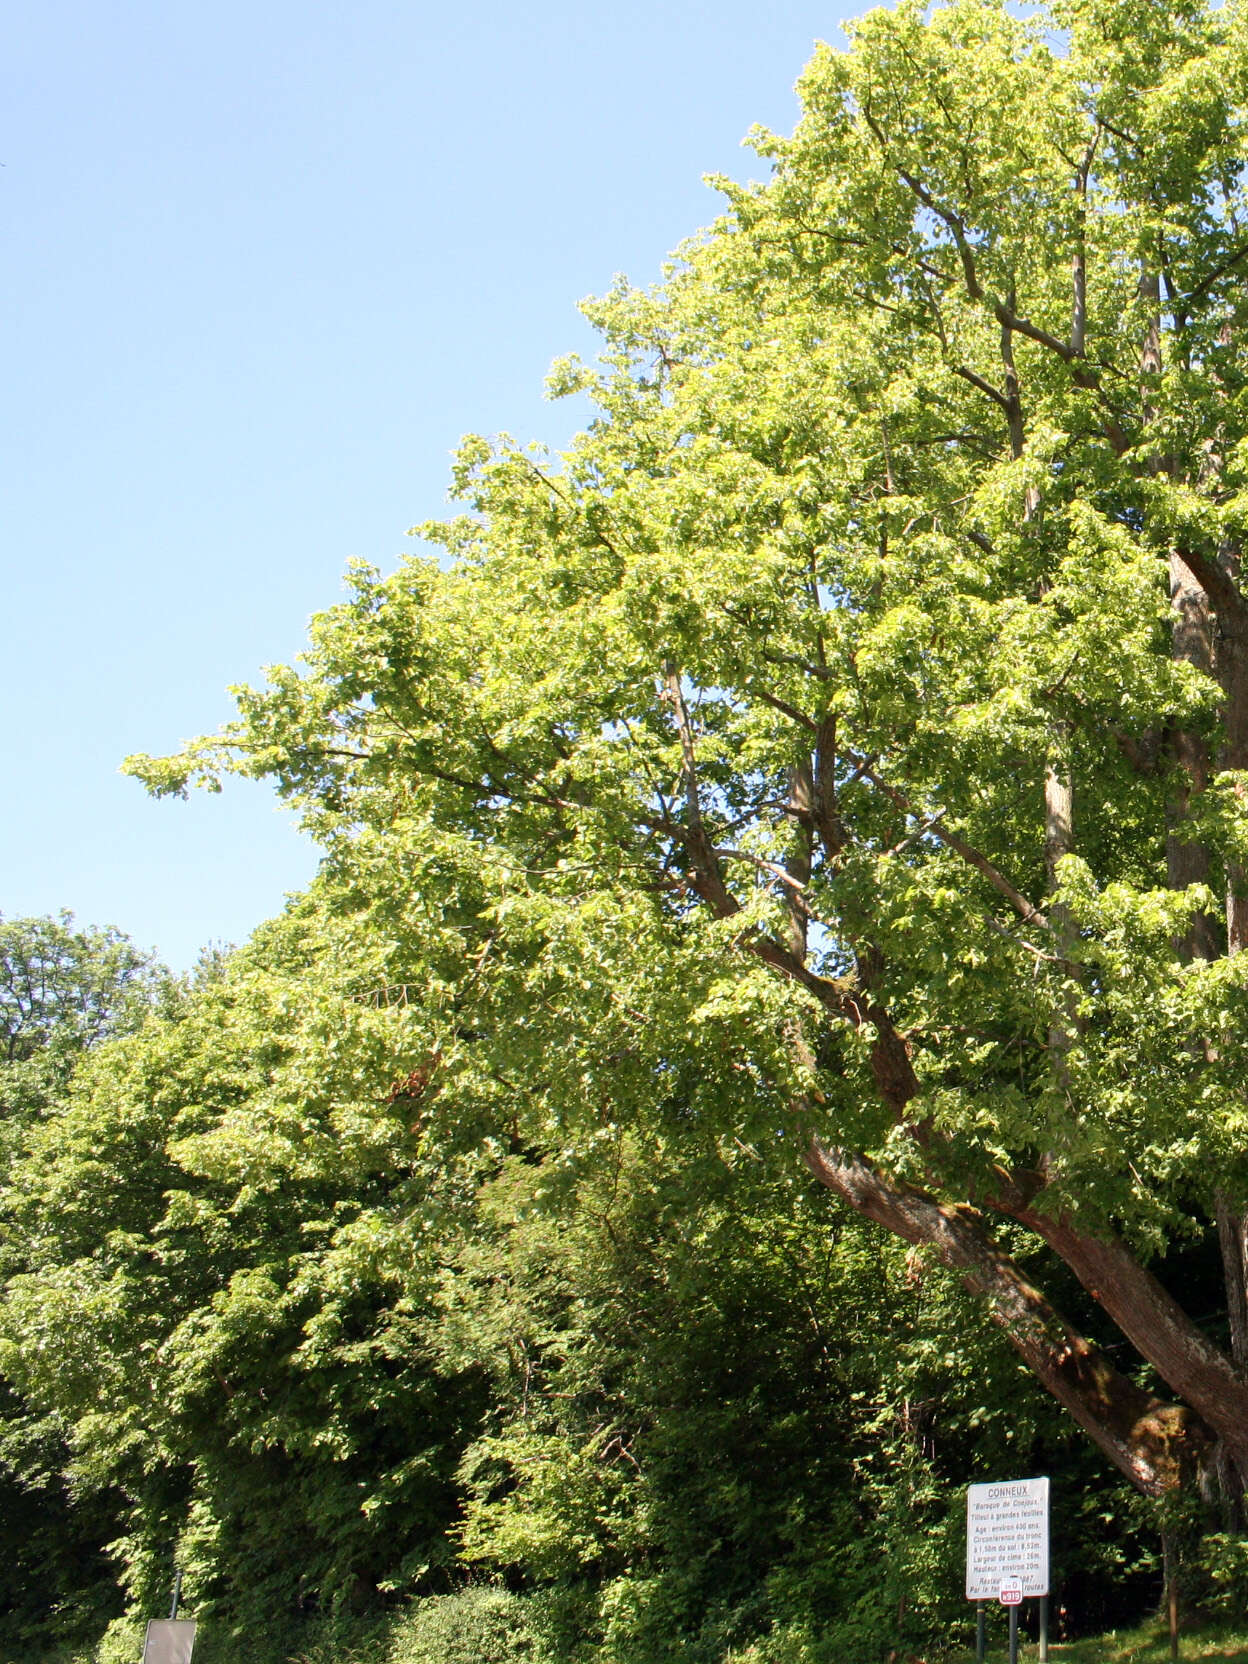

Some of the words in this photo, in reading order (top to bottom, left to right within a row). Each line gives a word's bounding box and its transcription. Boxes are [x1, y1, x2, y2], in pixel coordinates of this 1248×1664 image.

[988, 1486, 1027, 1497] CONNEUX
[996, 1512, 1019, 1522] grandes
[992, 1524, 1014, 1532] environ
[974, 1556, 997, 1564] Largeur
